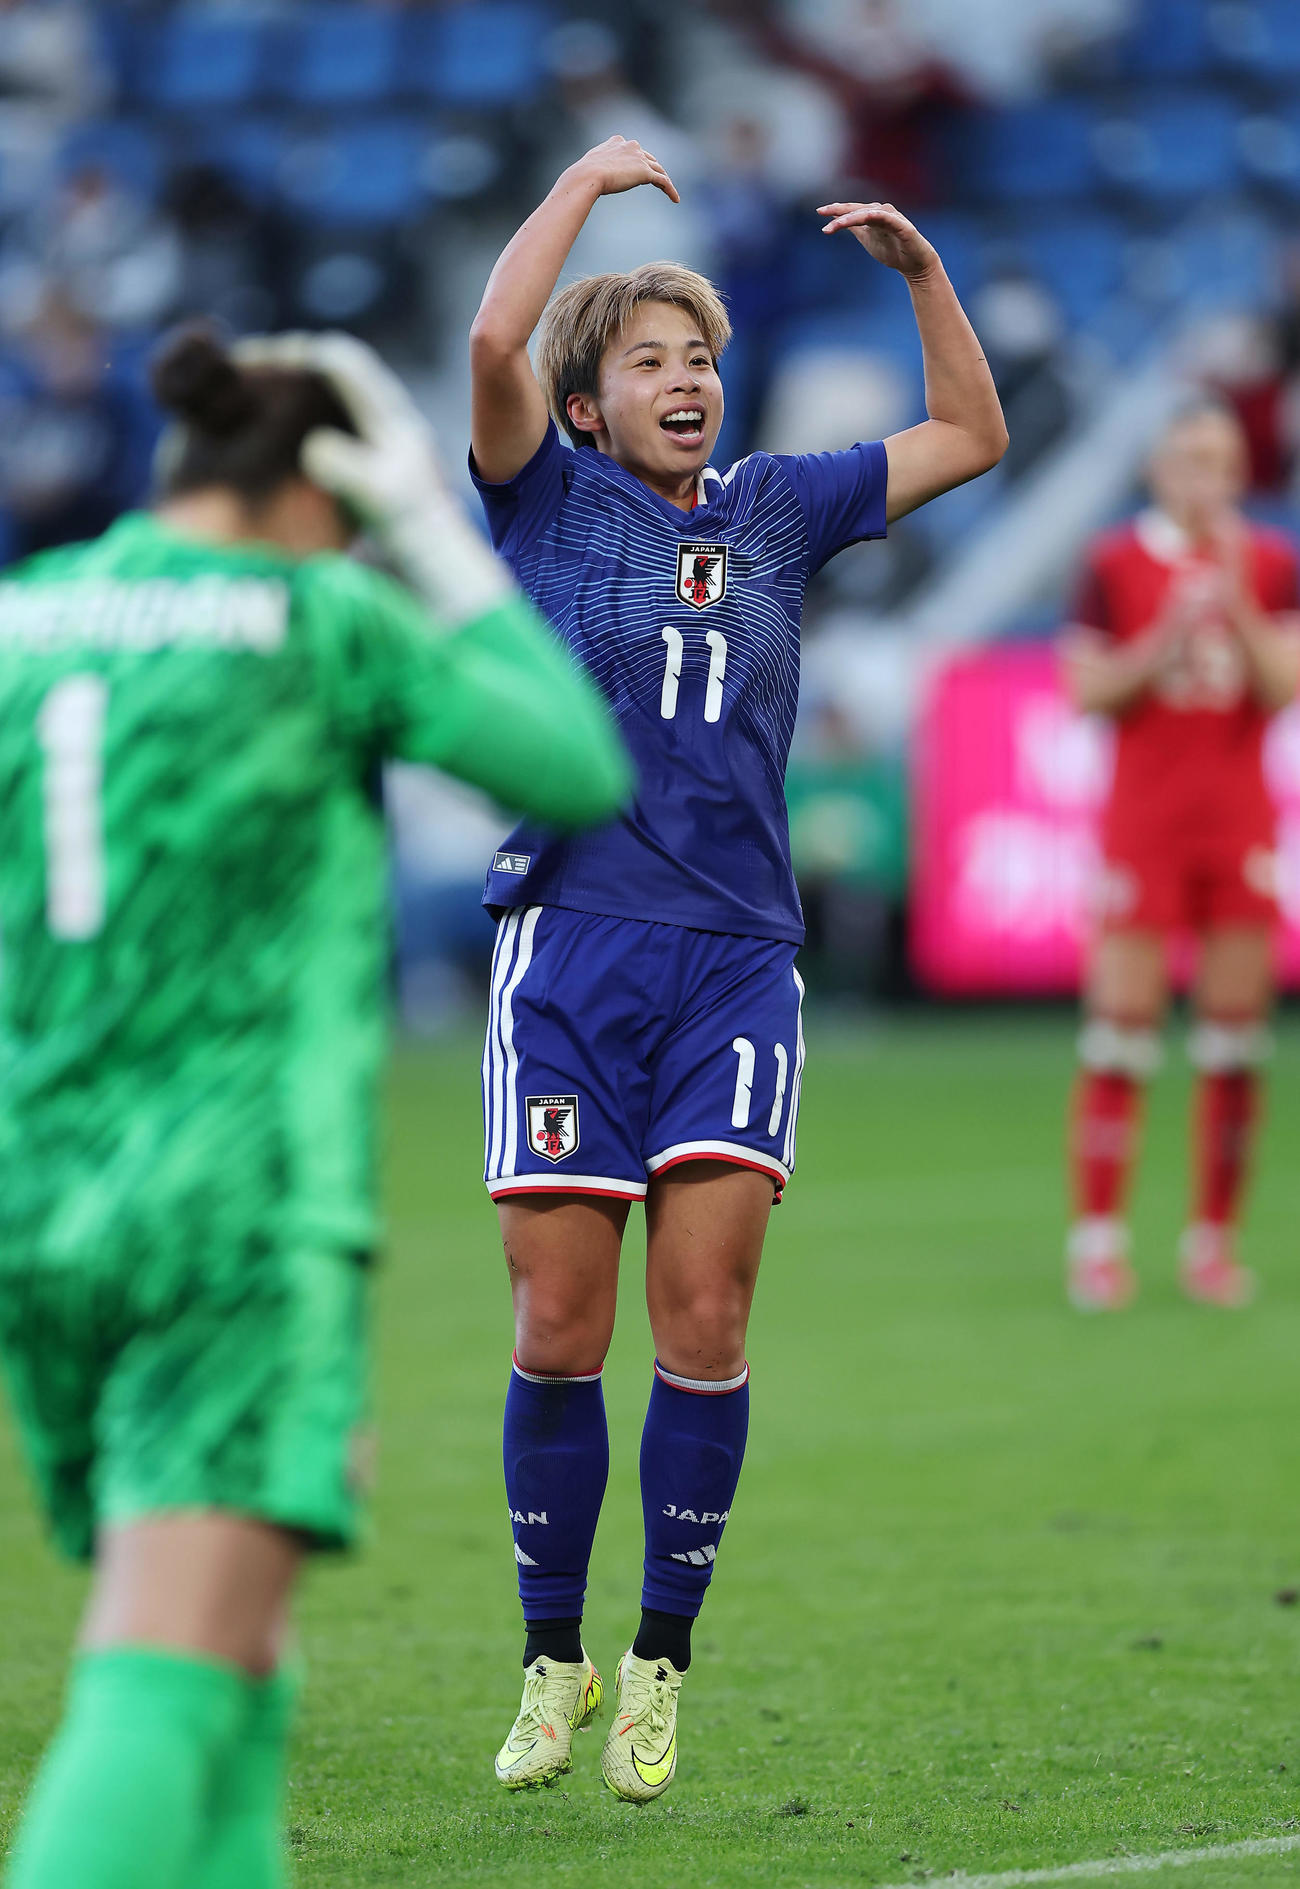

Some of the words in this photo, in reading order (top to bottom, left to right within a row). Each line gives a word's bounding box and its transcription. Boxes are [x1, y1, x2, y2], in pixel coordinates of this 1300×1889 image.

[688, 589, 711, 600] JFA
[660, 625, 728, 723] 11
[36, 672, 108, 941] 1
[731, 1037, 788, 1138] 11
[543, 1140, 565, 1151] JFA
